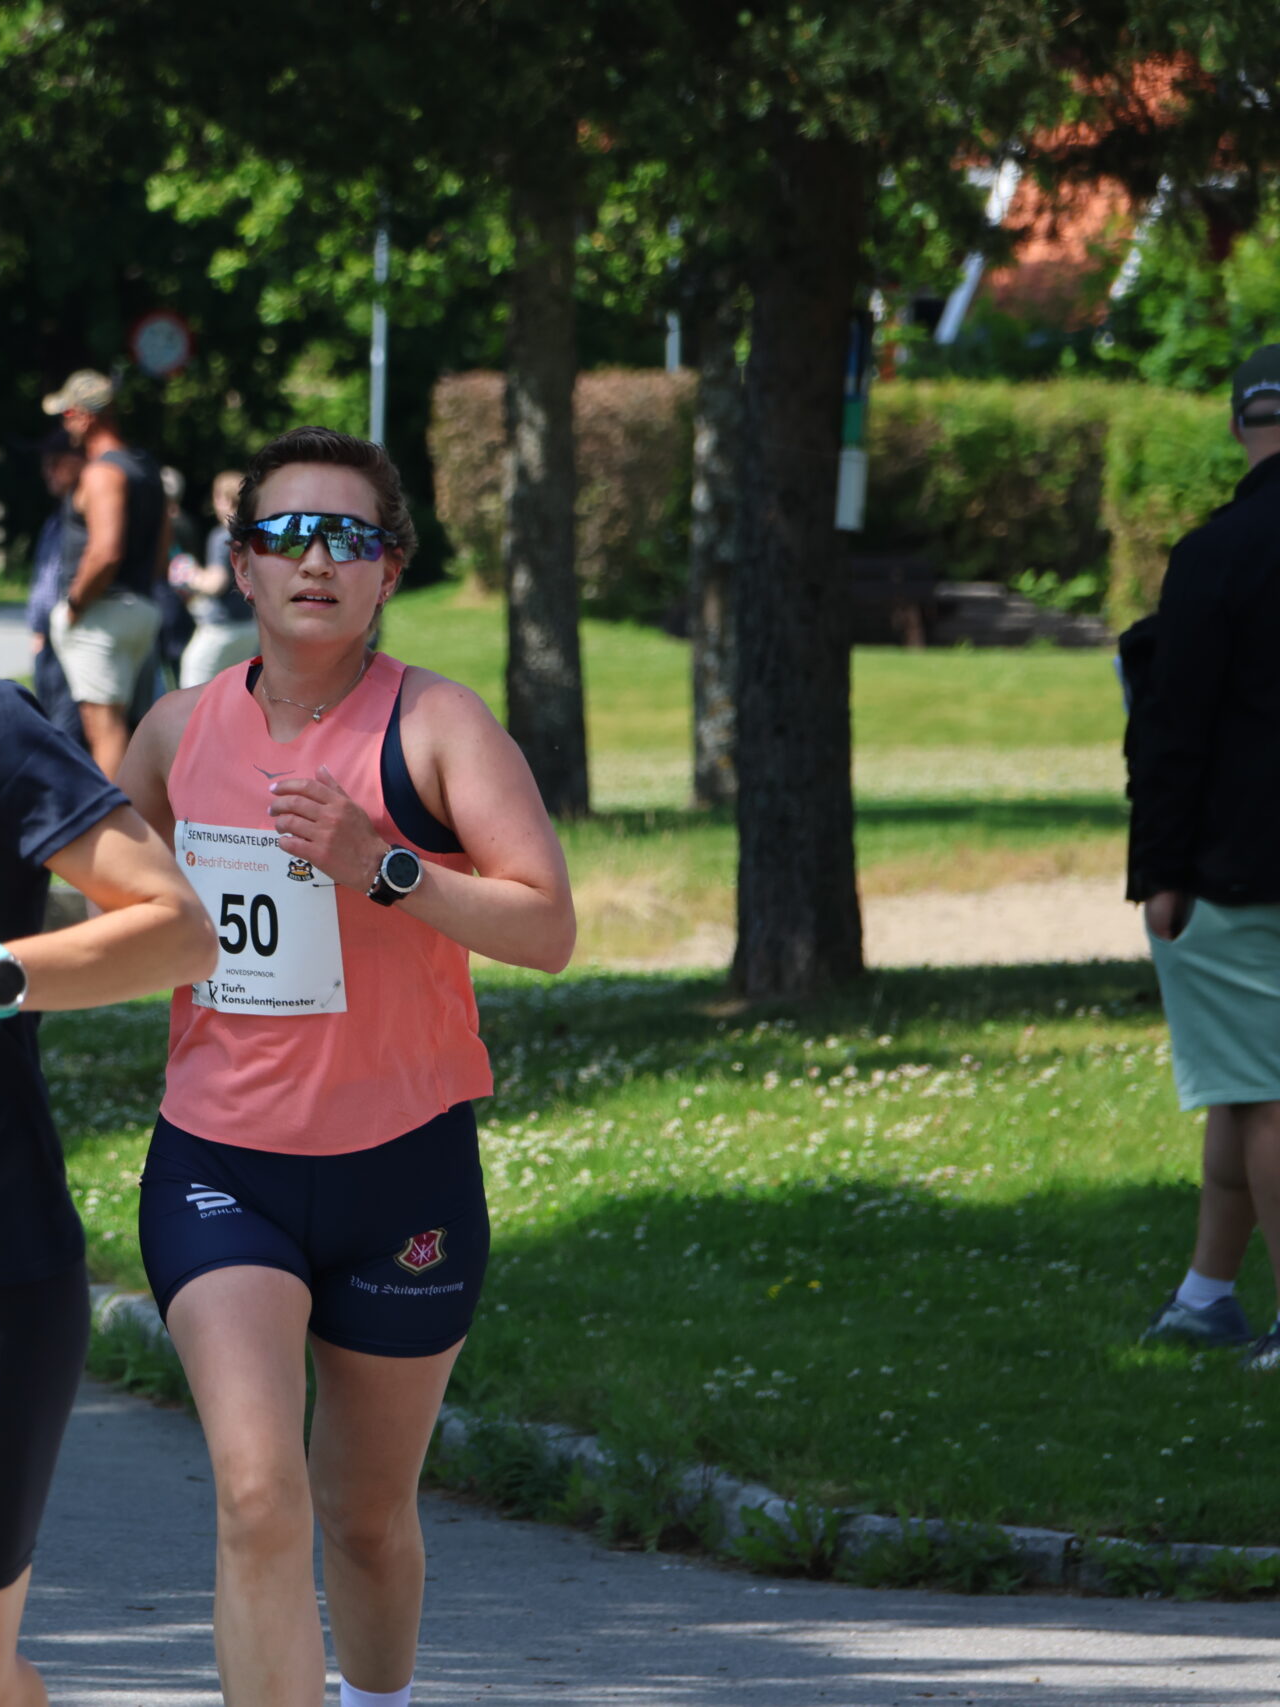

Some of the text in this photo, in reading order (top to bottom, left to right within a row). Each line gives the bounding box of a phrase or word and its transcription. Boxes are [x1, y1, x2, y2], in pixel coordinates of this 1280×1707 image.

[187, 829, 280, 848] SENTRUMSGATELØPE
[197, 855, 269, 872] Bedriftsidretten
[219, 893, 279, 957] 50
[221, 994, 316, 1008] Konsulenttjenester
